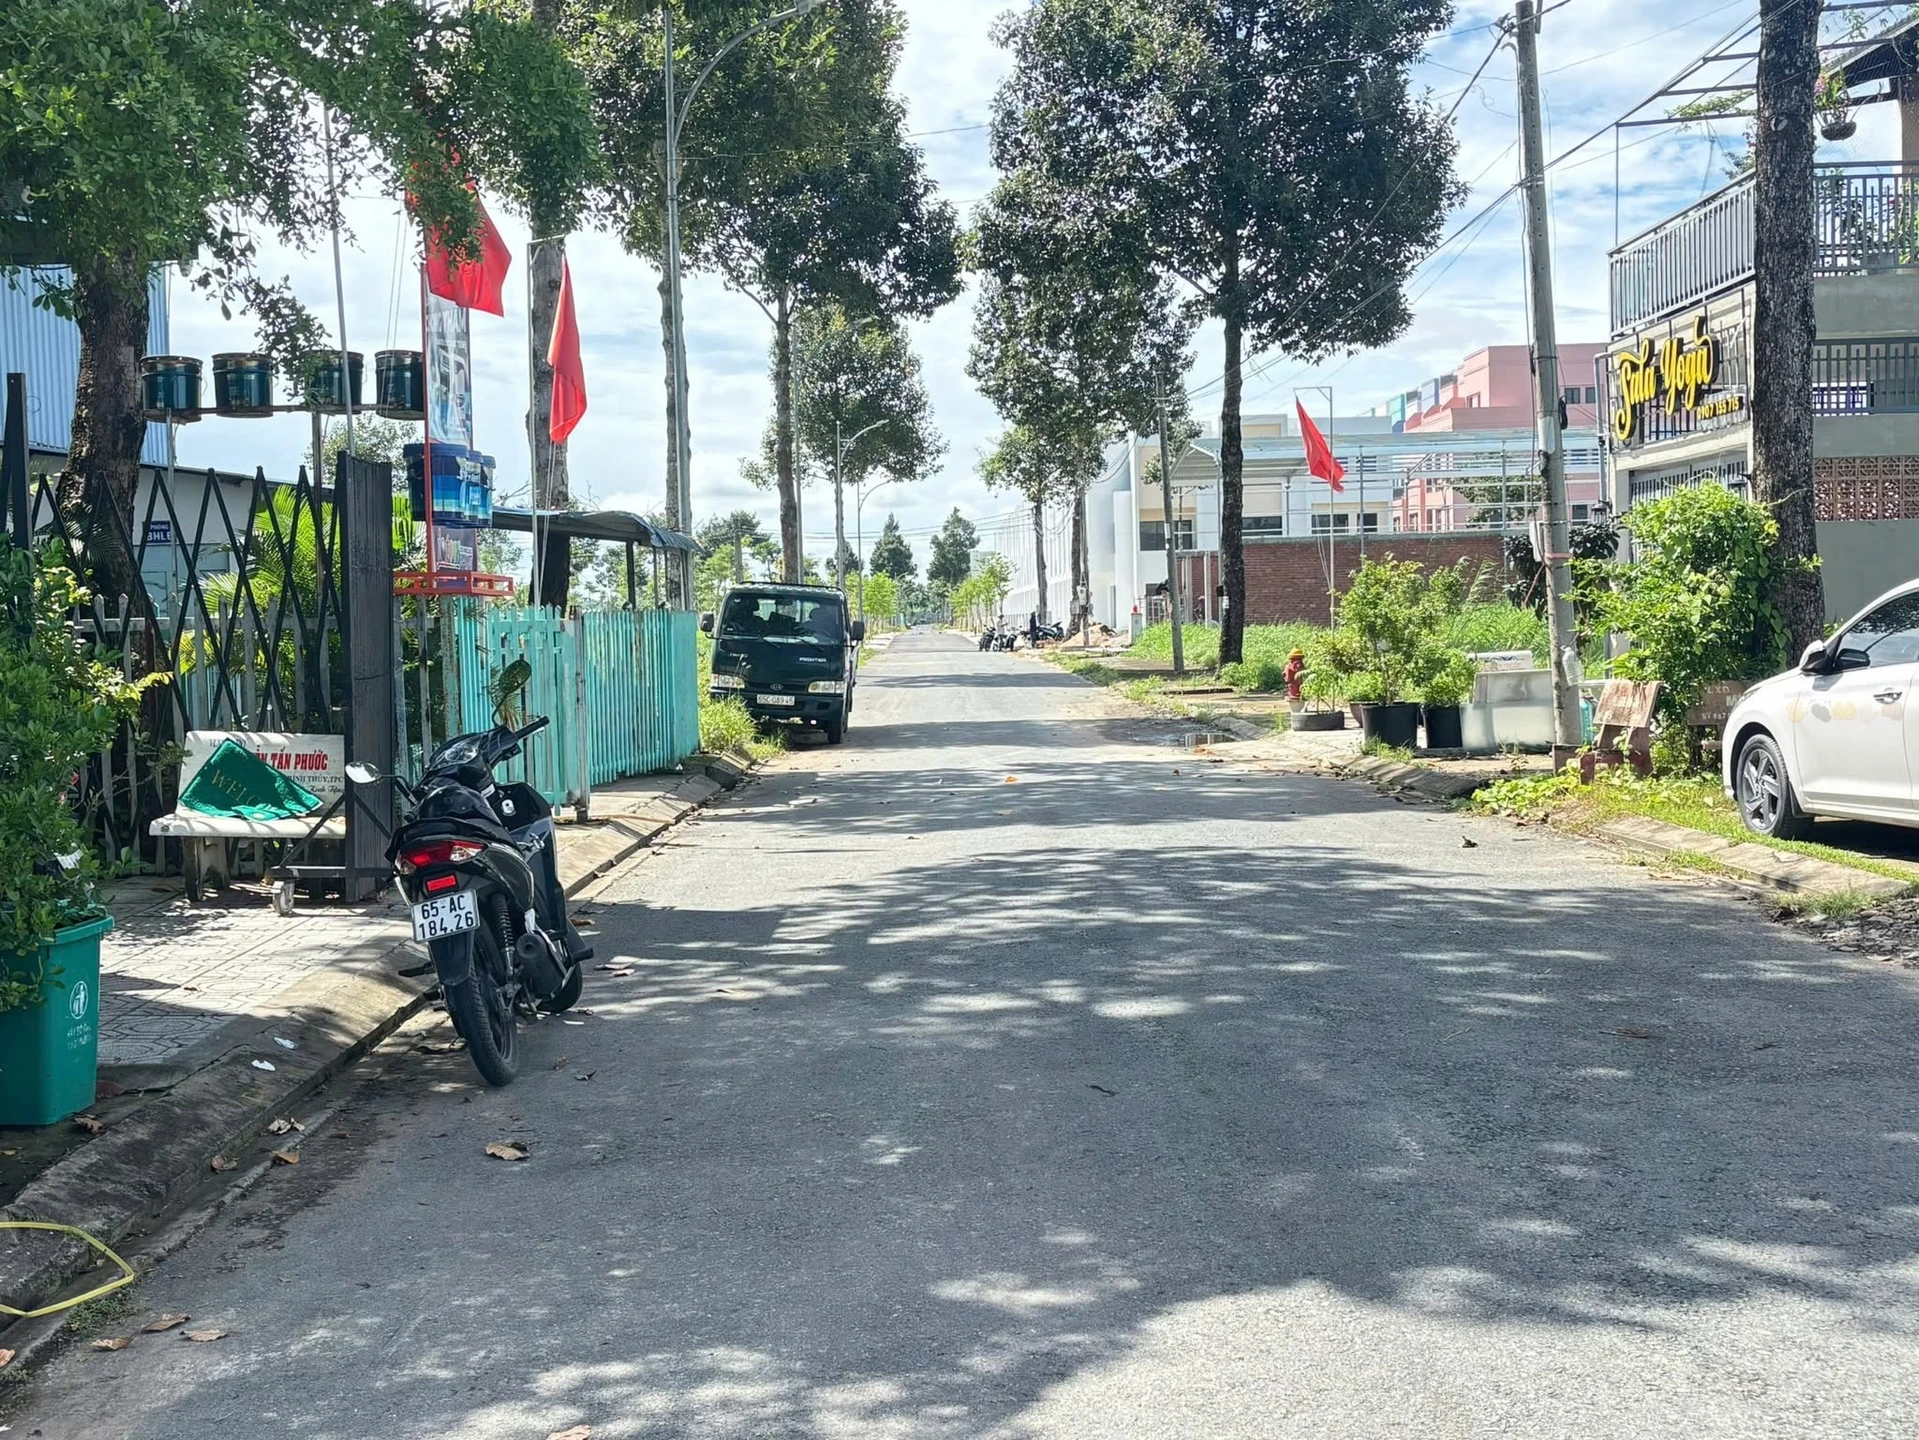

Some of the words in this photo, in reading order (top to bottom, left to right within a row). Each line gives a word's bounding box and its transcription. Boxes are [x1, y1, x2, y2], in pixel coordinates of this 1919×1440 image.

[1615, 338, 1656, 440] Sala
[1661, 315, 1714, 416] Yoga
[270, 746, 291, 770] TẤN
[294, 749, 328, 771] PHƯỚC
[421, 895, 466, 919] 65-AC
[419, 911, 474, 939] 184.26
